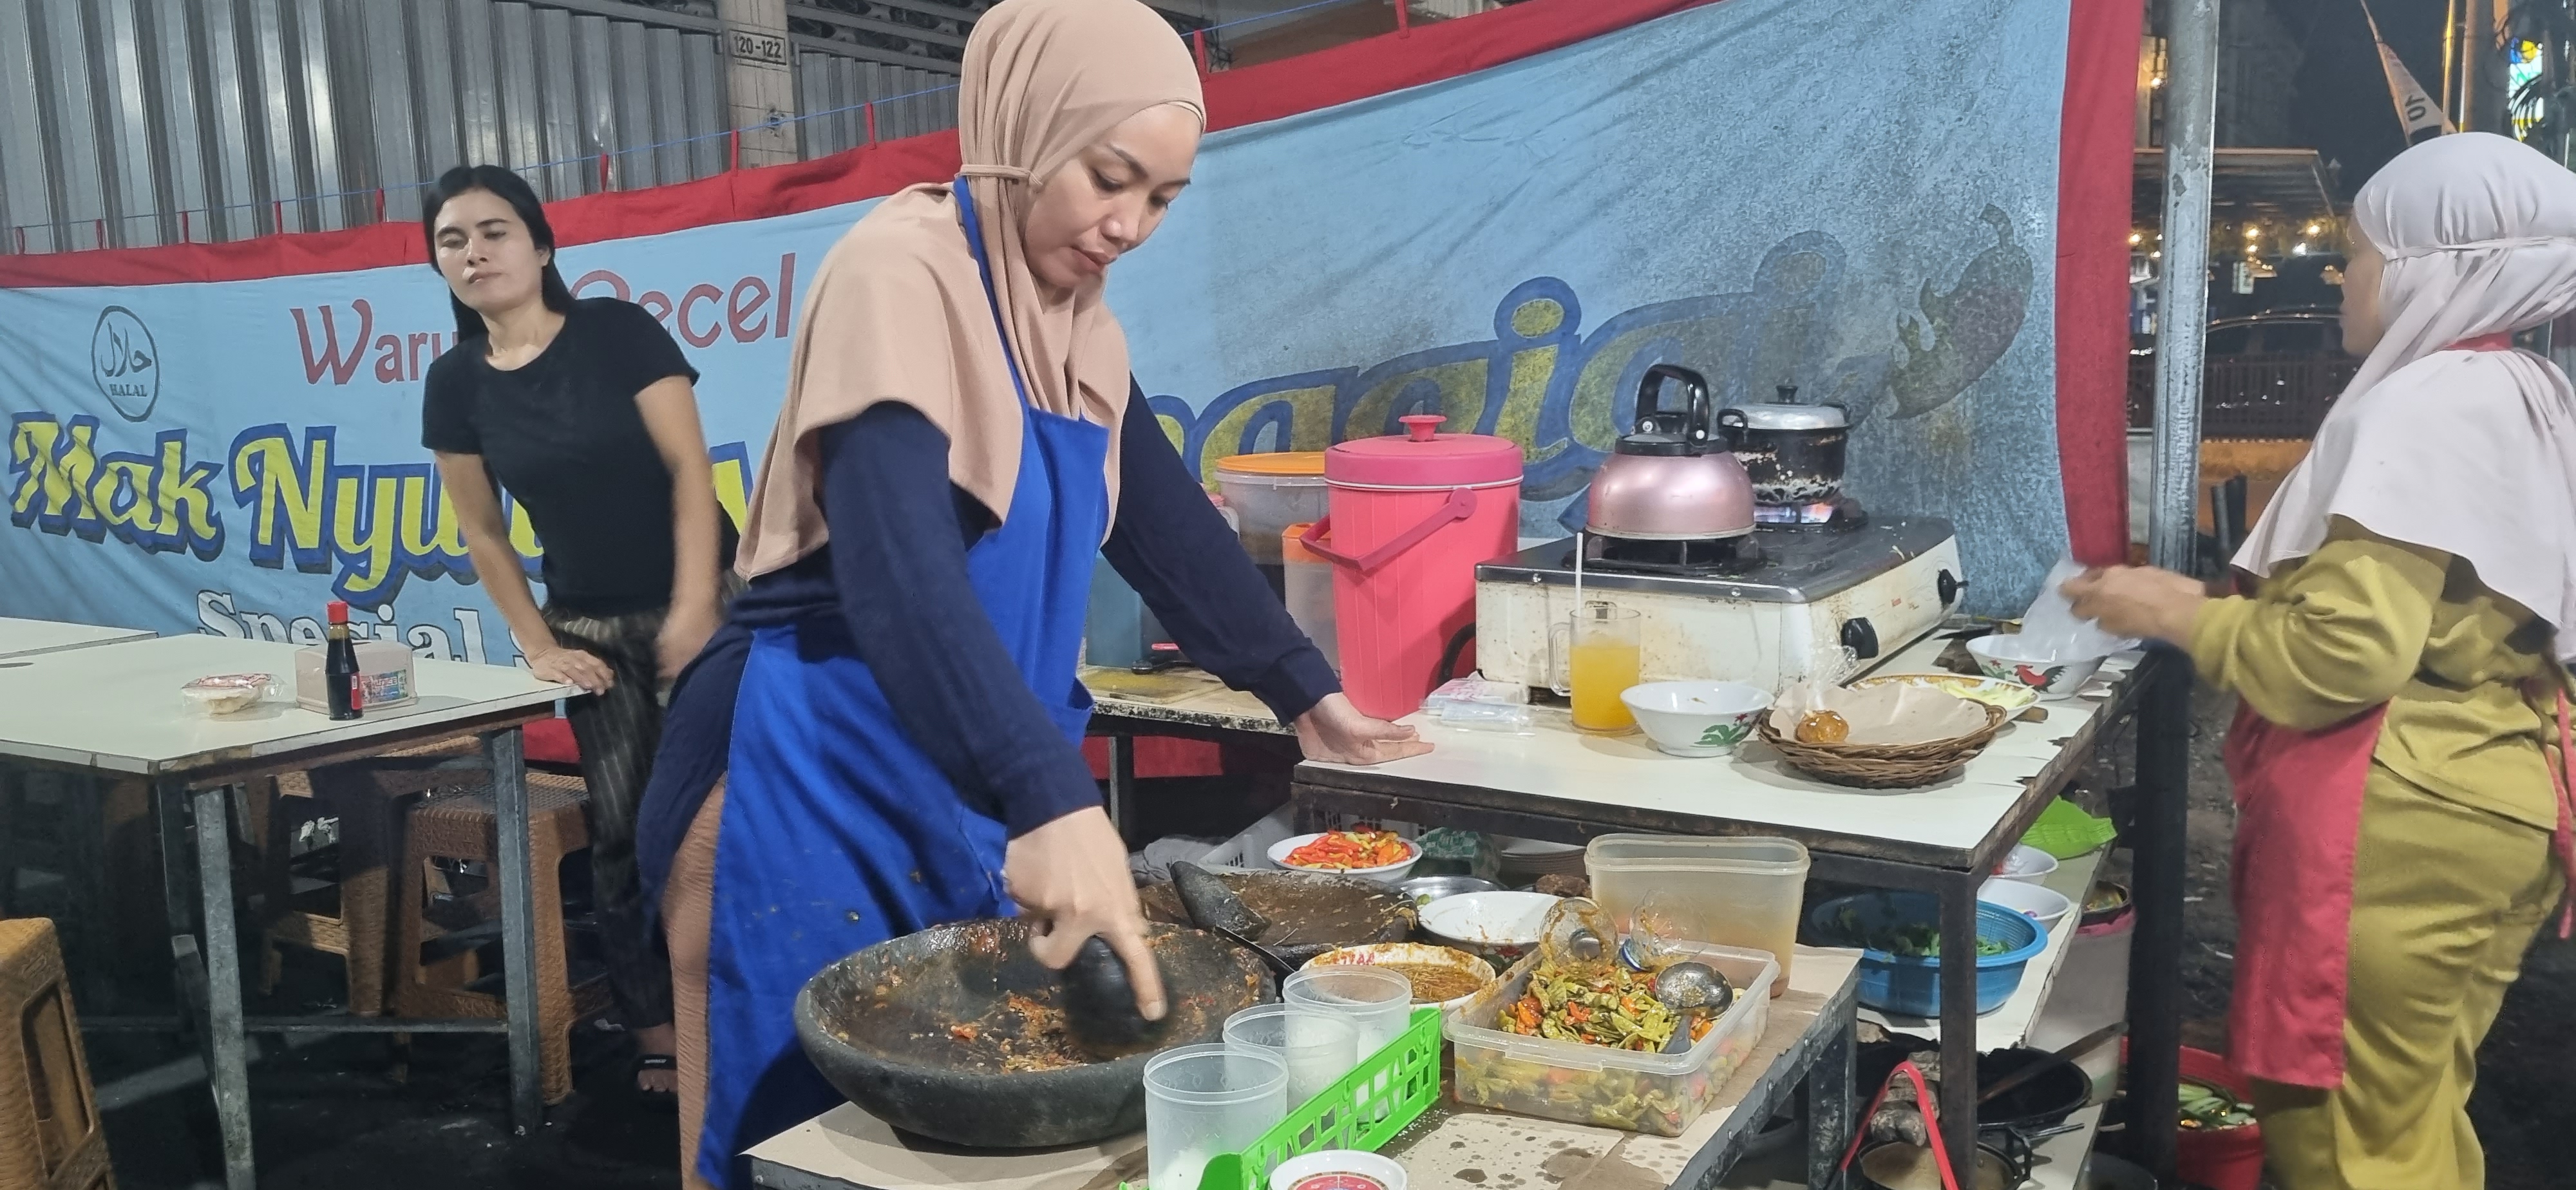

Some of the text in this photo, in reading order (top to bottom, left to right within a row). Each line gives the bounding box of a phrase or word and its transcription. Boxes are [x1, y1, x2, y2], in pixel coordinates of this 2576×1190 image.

[734, 35, 782, 58] 120-122
[100, 321, 152, 377] حلال
[109, 384, 147, 397] HALAL
[9, 411, 225, 562] Mak
